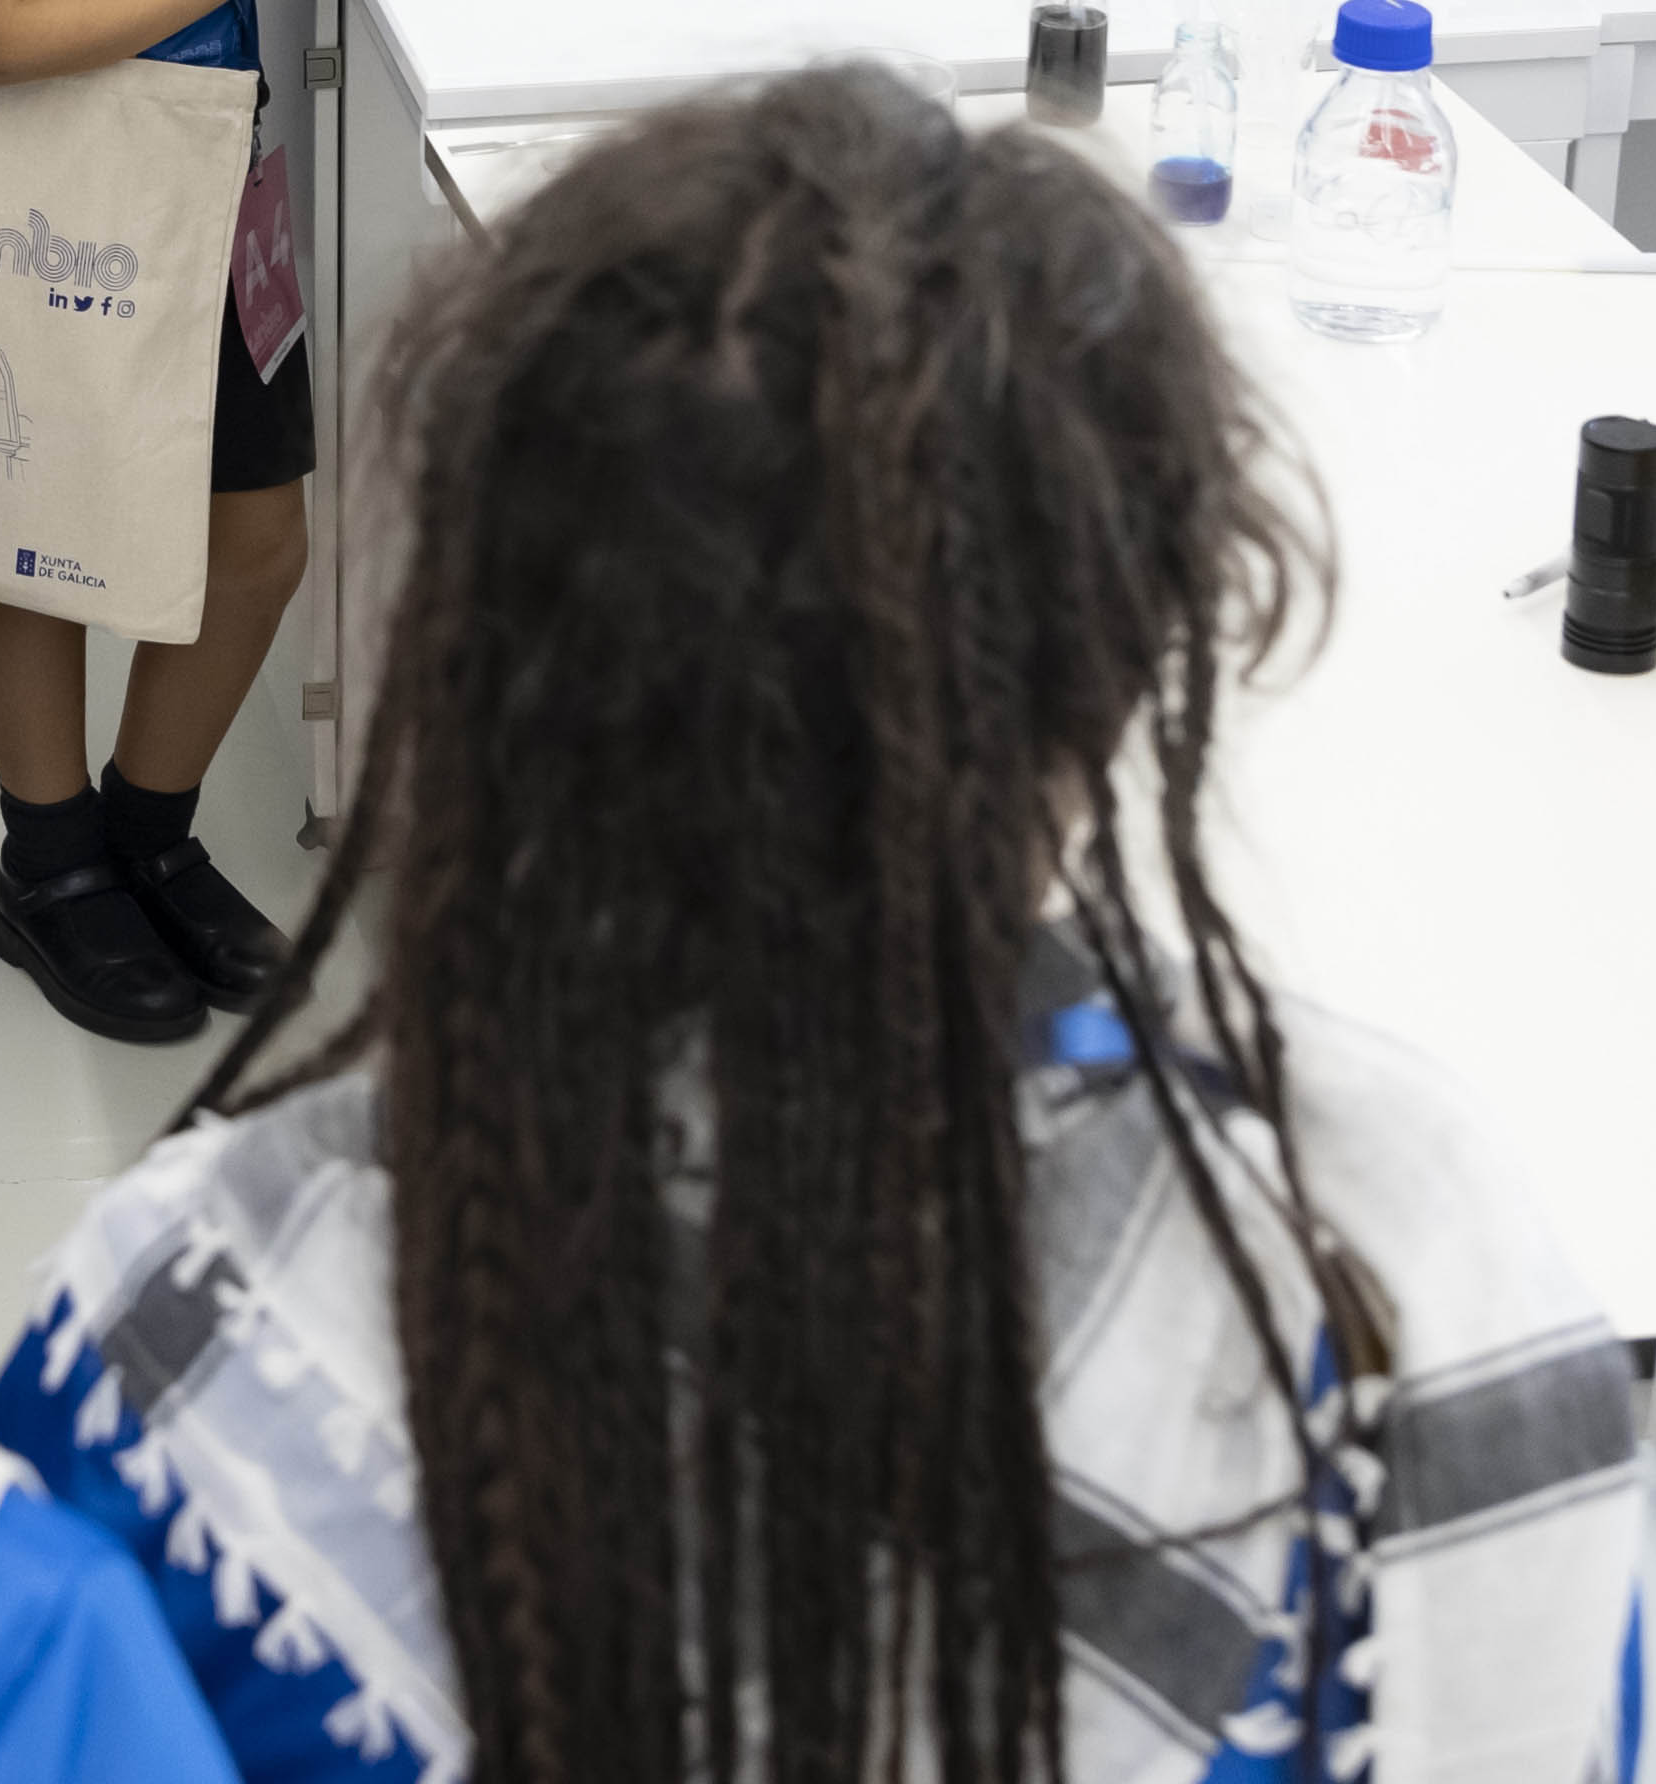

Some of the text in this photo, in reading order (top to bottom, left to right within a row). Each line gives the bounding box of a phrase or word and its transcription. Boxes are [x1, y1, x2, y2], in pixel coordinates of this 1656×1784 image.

[40, 554, 82, 572] XUNTA
[38, 566, 107, 590] DE GALICIA
